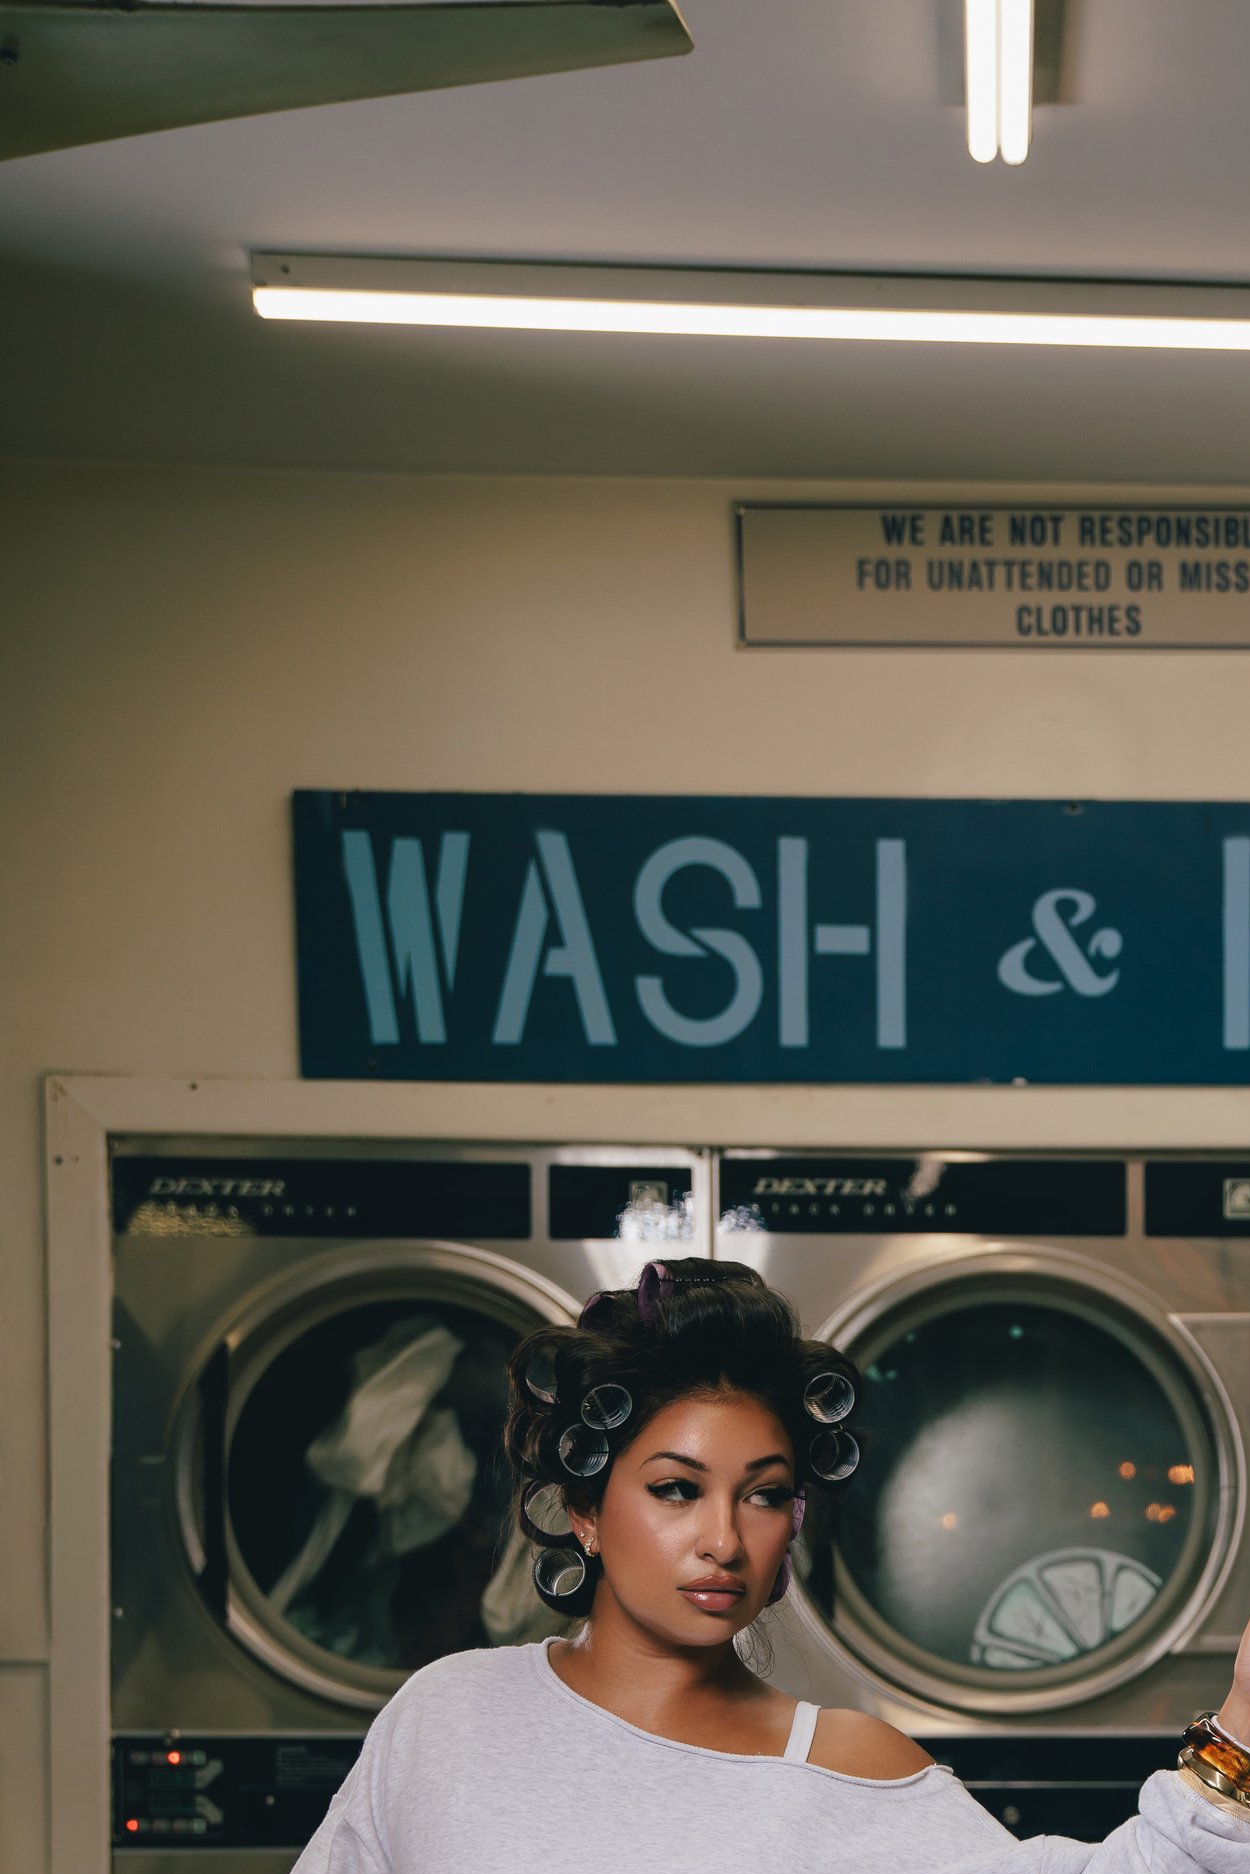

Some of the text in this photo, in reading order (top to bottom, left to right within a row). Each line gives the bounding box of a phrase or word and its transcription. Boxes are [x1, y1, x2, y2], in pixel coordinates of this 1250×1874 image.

[881, 514, 925, 547] WE
[940, 514, 993, 547] ARE
[1009, 514, 1064, 547] NOT
[857, 559, 911, 591] FOR
[928, 559, 1111, 591] UNATTENDED
[1127, 560, 1163, 592] OR
[1017, 604, 1142, 636] CLOTHES
[343, 829, 907, 1049] WASH
[999, 887, 1124, 997] &
[150, 1176, 286, 1197] DEXTER
[754, 1178, 887, 1195] DEXTER
